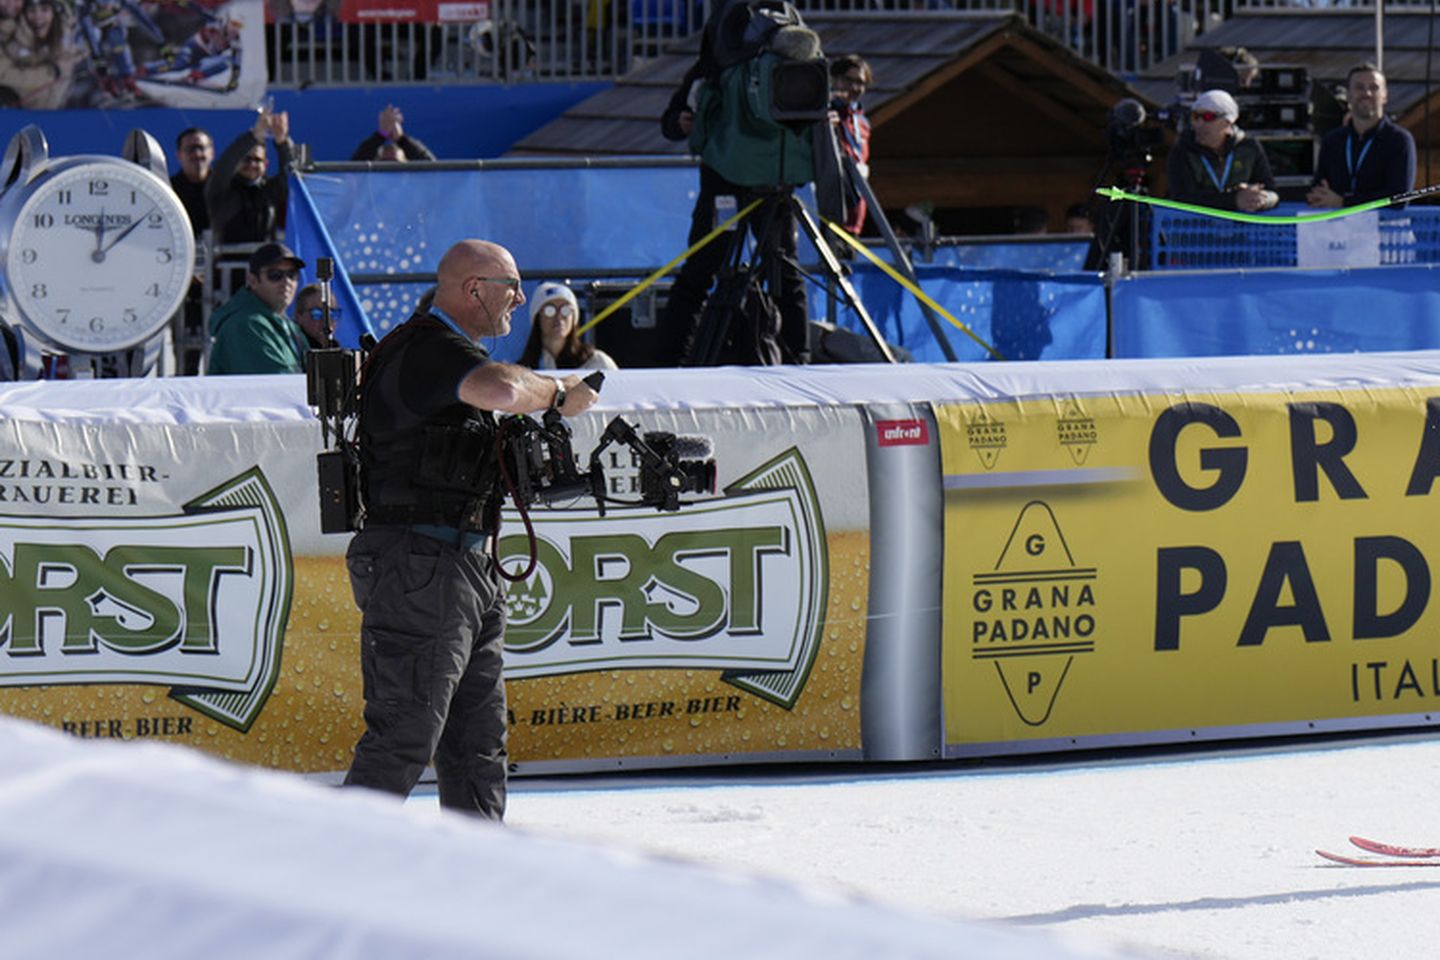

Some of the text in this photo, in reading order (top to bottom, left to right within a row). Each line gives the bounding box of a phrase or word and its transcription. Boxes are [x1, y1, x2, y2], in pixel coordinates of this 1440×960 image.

[88, 181, 109, 196] 12
[58, 191, 71, 205] 11
[34, 214, 54, 229] 10
[64, 214, 132, 225] LONGNES
[148, 215, 163, 229] 2
[22, 248, 38, 264] 9
[156, 248, 172, 264] 3
[32, 283, 48, 299] 8
[145, 283, 161, 298] 4
[56, 308, 71, 324] 7
[123, 308, 138, 323] 5
[89, 317, 104, 333] 6
[1025, 534, 1046, 556] G
[499, 526, 791, 653] ORST
[0, 542, 254, 656] RST
[972, 585, 1096, 613] GRANA
[972, 614, 1096, 643] PADANO
[1027, 671, 1041, 694] P
